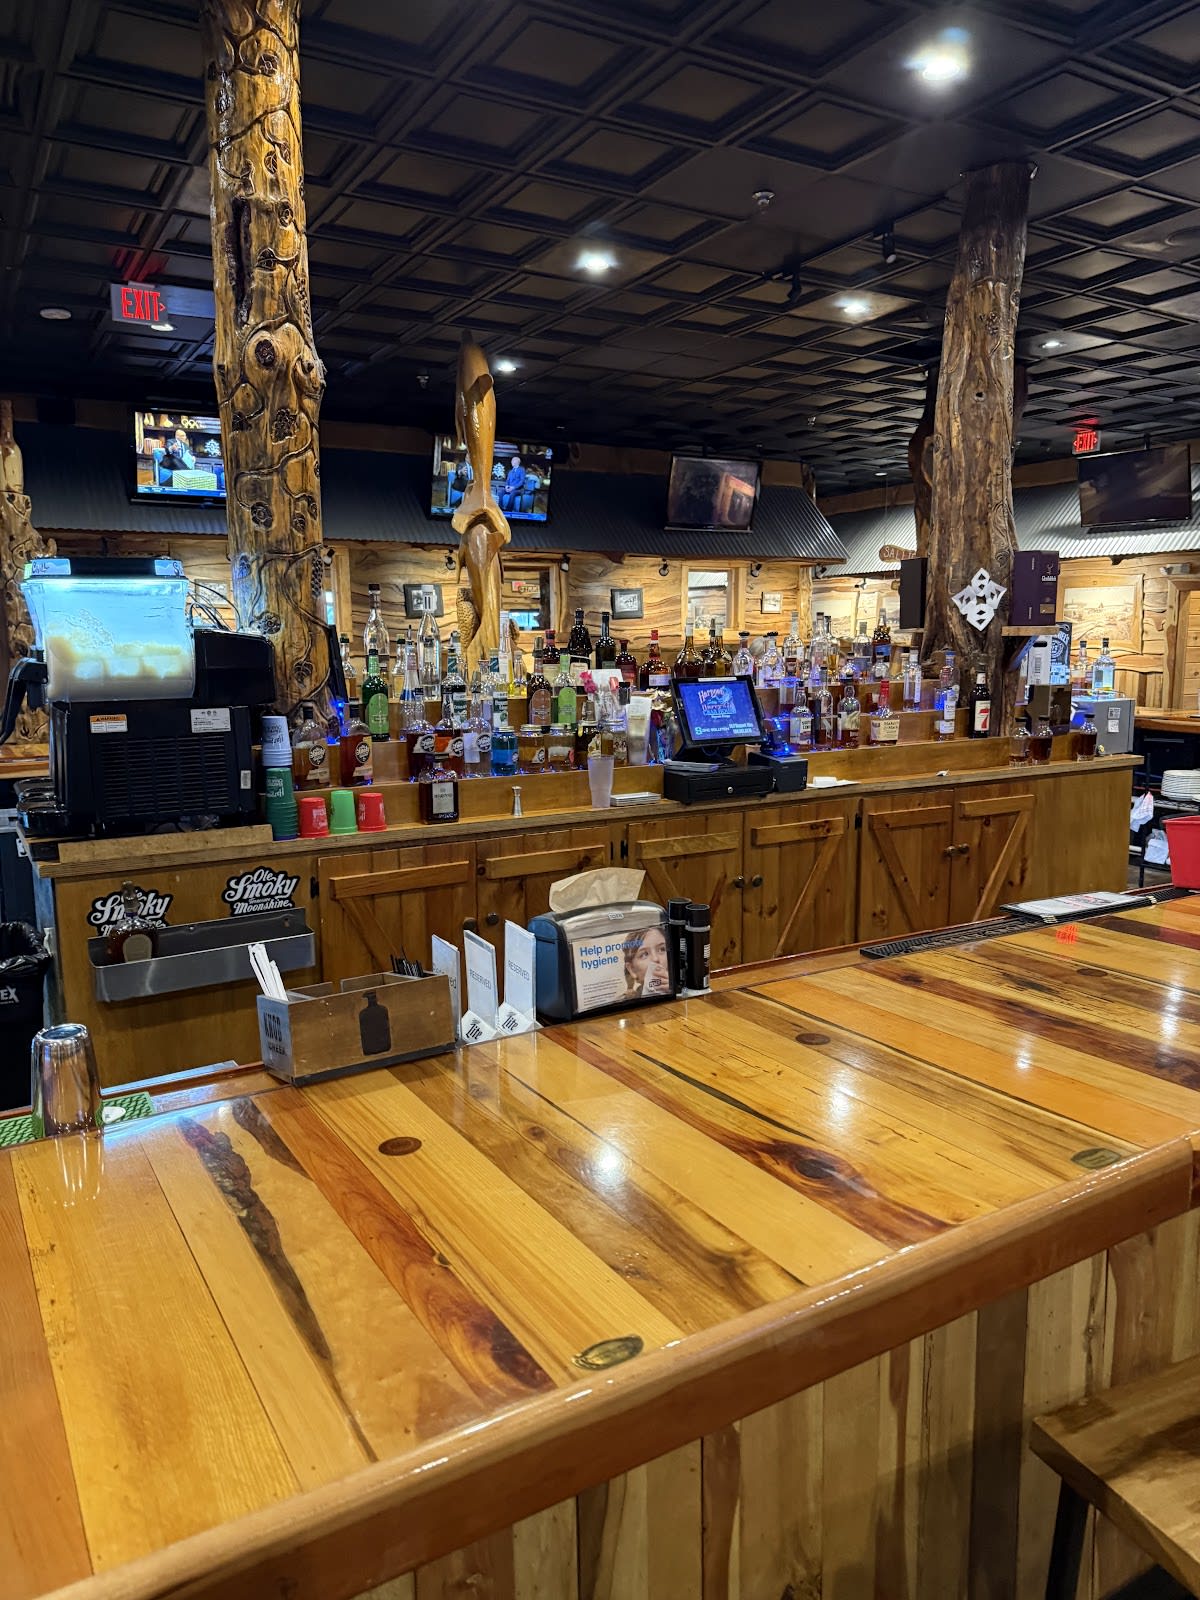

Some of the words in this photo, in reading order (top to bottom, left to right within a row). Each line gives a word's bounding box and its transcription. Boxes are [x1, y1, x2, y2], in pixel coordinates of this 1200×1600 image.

[121, 287, 160, 322] EXIT
[1075, 431, 1095, 452] EXIT
[254, 869, 276, 883] Ole
[224, 874, 298, 901] Smoky
[233, 899, 292, 914] Moonshine
[580, 945, 603, 957] Help
[508, 960, 530, 981] RESERVED
[581, 955, 619, 970] hygiene
[469, 968, 491, 990] RESERVED
[466, 1023, 482, 1040] Lite
[502, 1015, 518, 1031] Lite
